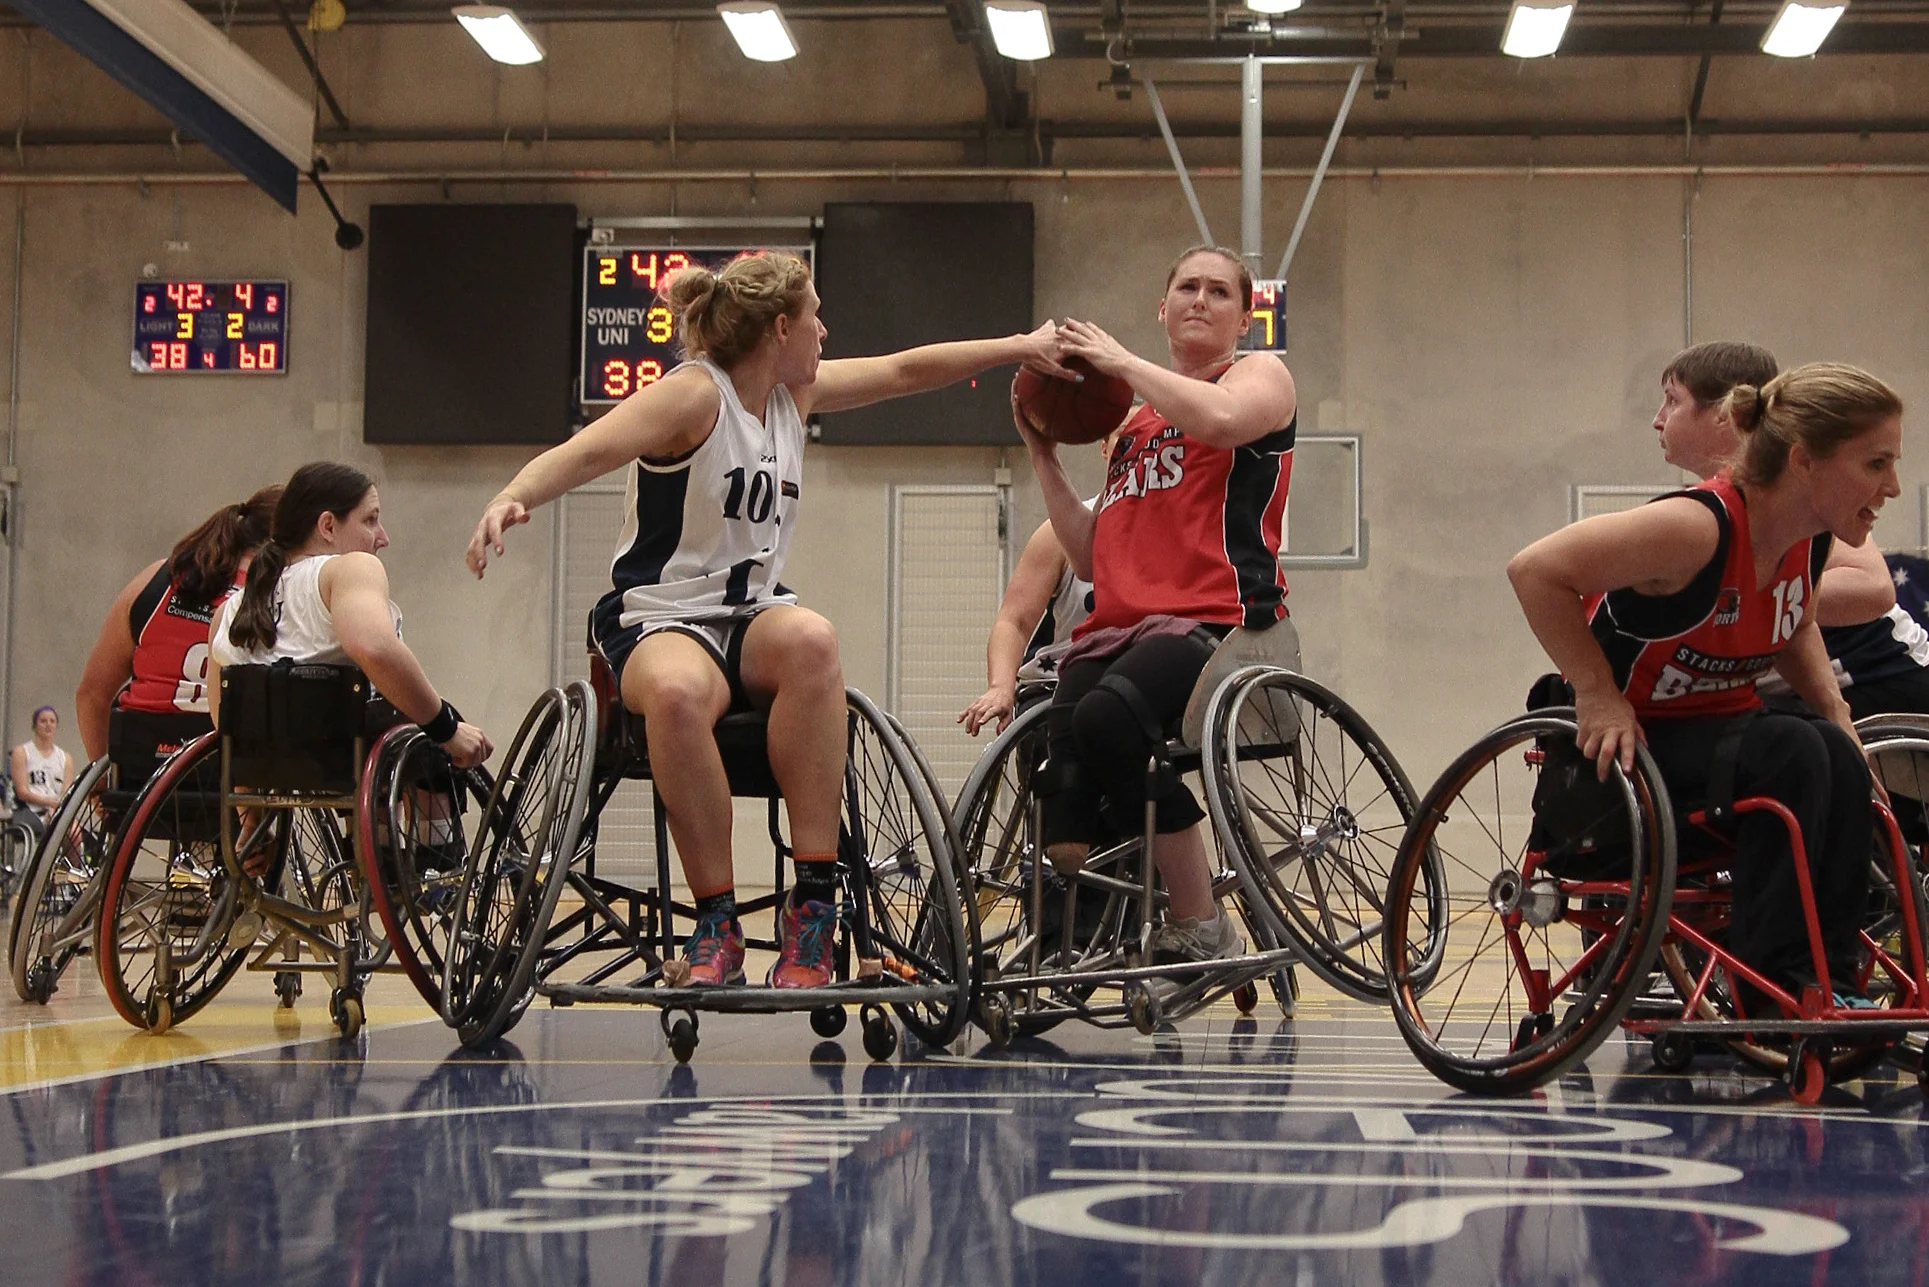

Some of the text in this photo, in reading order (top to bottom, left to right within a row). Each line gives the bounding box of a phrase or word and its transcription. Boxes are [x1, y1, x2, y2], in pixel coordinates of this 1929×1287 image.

[600, 258, 616, 285] 2
[144, 296, 156, 312] 2
[236, 284, 252, 309] 4
[266, 296, 278, 312] 2
[1263, 283, 1275, 304] 4
[140, 320, 173, 332] LIGHT
[177, 313, 193, 339] 3
[227, 313, 243, 339] 2
[248, 320, 280, 332] DARK
[587, 307, 646, 326] SYDNEY
[647, 307, 673, 343] 3
[1252, 310, 1273, 346] 7
[597, 328, 629, 345] UNI
[151, 343, 186, 369] 38
[203, 352, 214, 368] 4
[240, 343, 276, 369] 60
[604, 361, 661, 396] 38
[723, 467, 773, 523] 10
[1771, 575, 1804, 645] 13
[1677, 648, 1737, 672] STACKS
[29, 770, 46, 785] 13
